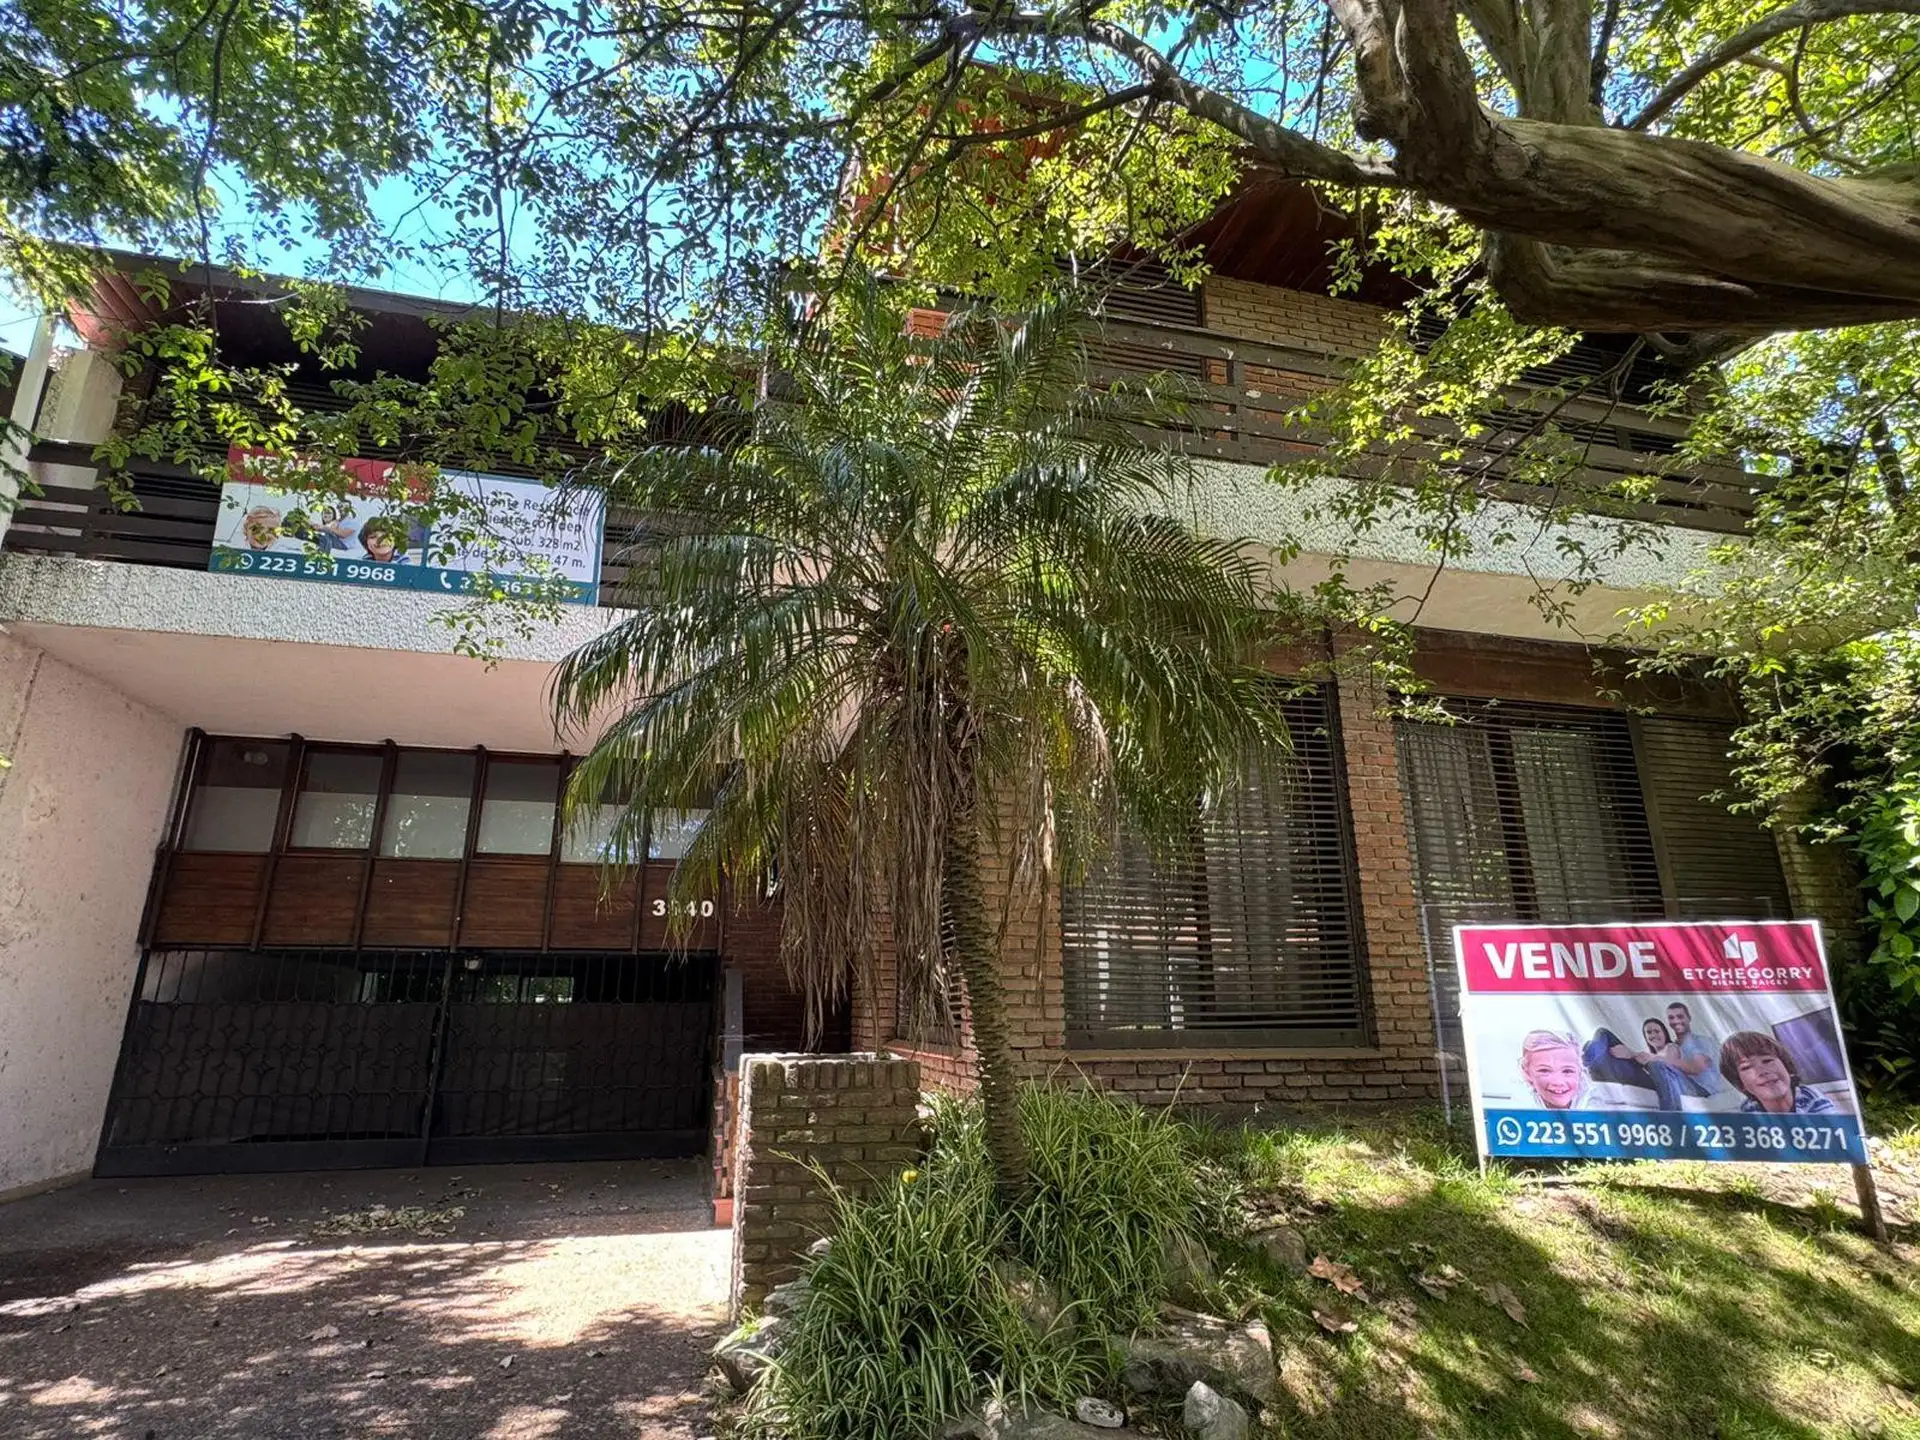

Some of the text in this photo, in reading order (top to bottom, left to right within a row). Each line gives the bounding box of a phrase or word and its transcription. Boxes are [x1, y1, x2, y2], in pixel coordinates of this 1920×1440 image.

[538, 536, 559, 549] 328
[258, 556, 297, 572] 223
[346, 564, 396, 582] 9968
[571, 558, 586, 568] m.
[1482, 941, 1661, 980] VENDE
[1682, 967, 1813, 980] ETCHEGORRY
[1526, 1119, 1848, 1151] 223 551 9968 / 223 368 8271
